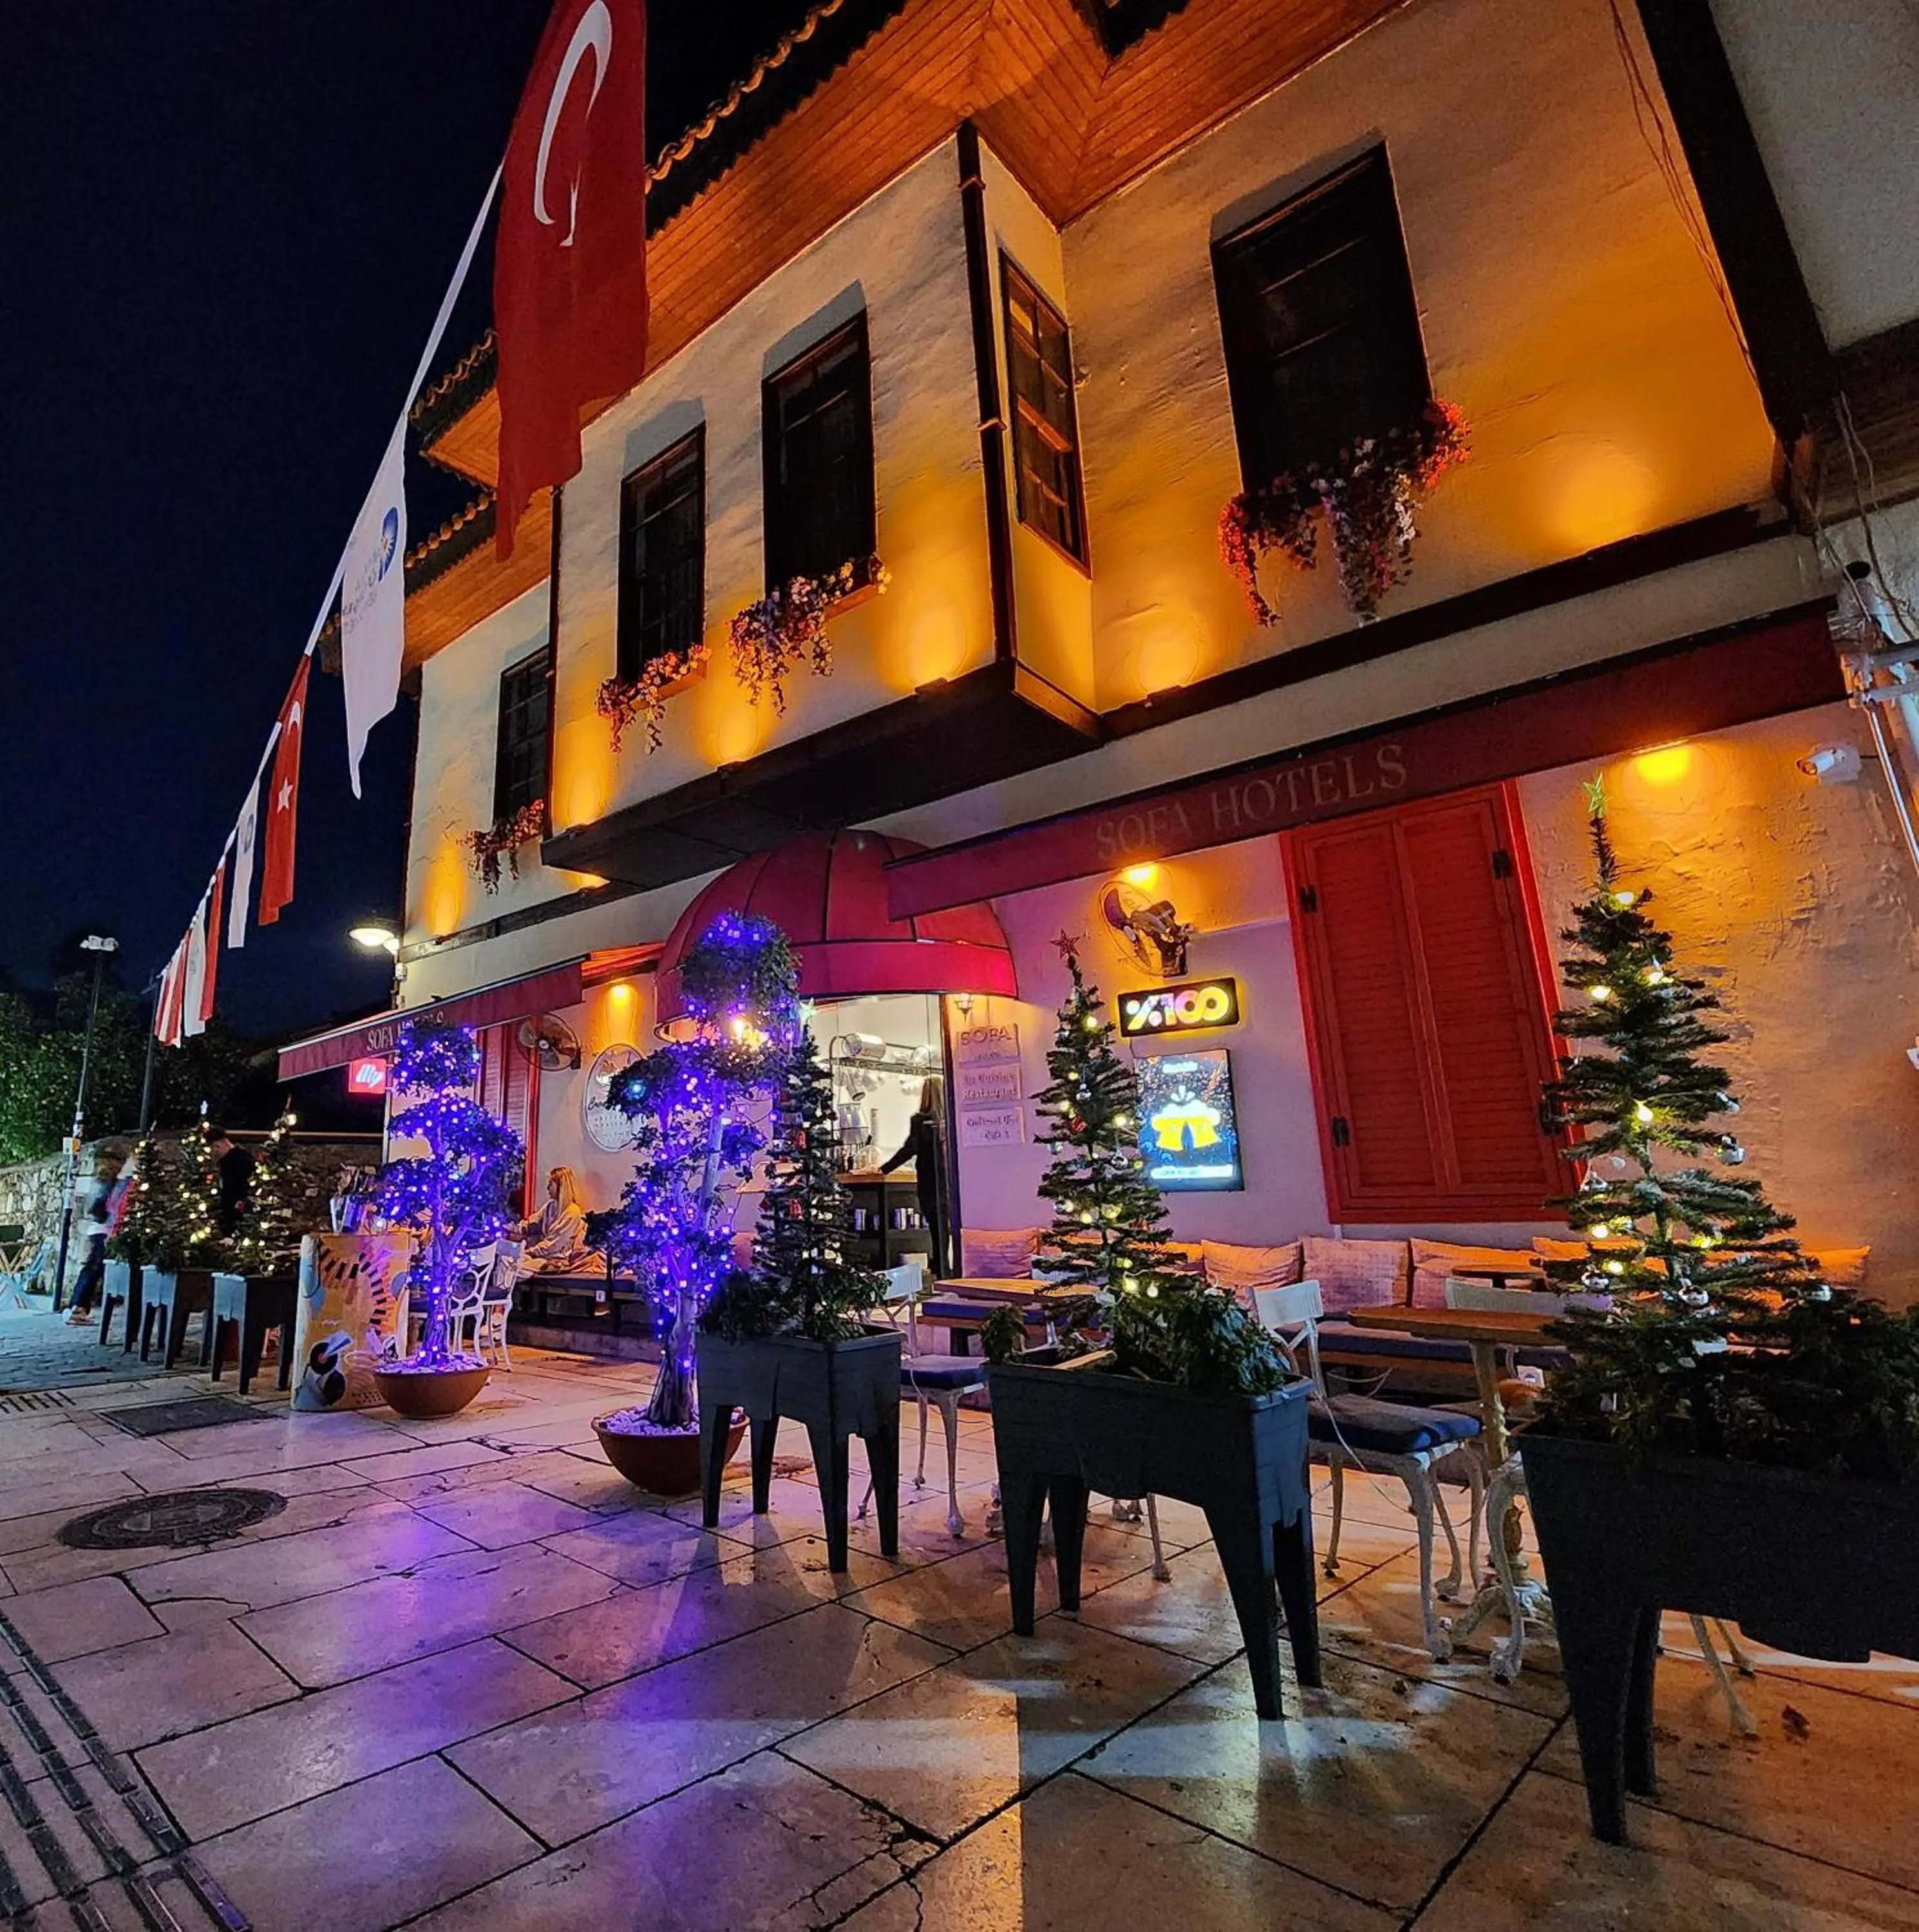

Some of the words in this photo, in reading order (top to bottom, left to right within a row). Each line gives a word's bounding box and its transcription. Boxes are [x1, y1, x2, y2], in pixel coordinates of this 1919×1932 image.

[1096, 801, 1190, 861] SOFA
[1211, 744, 1408, 832] HOTELS
[366, 1025, 393, 1052] SOFA
